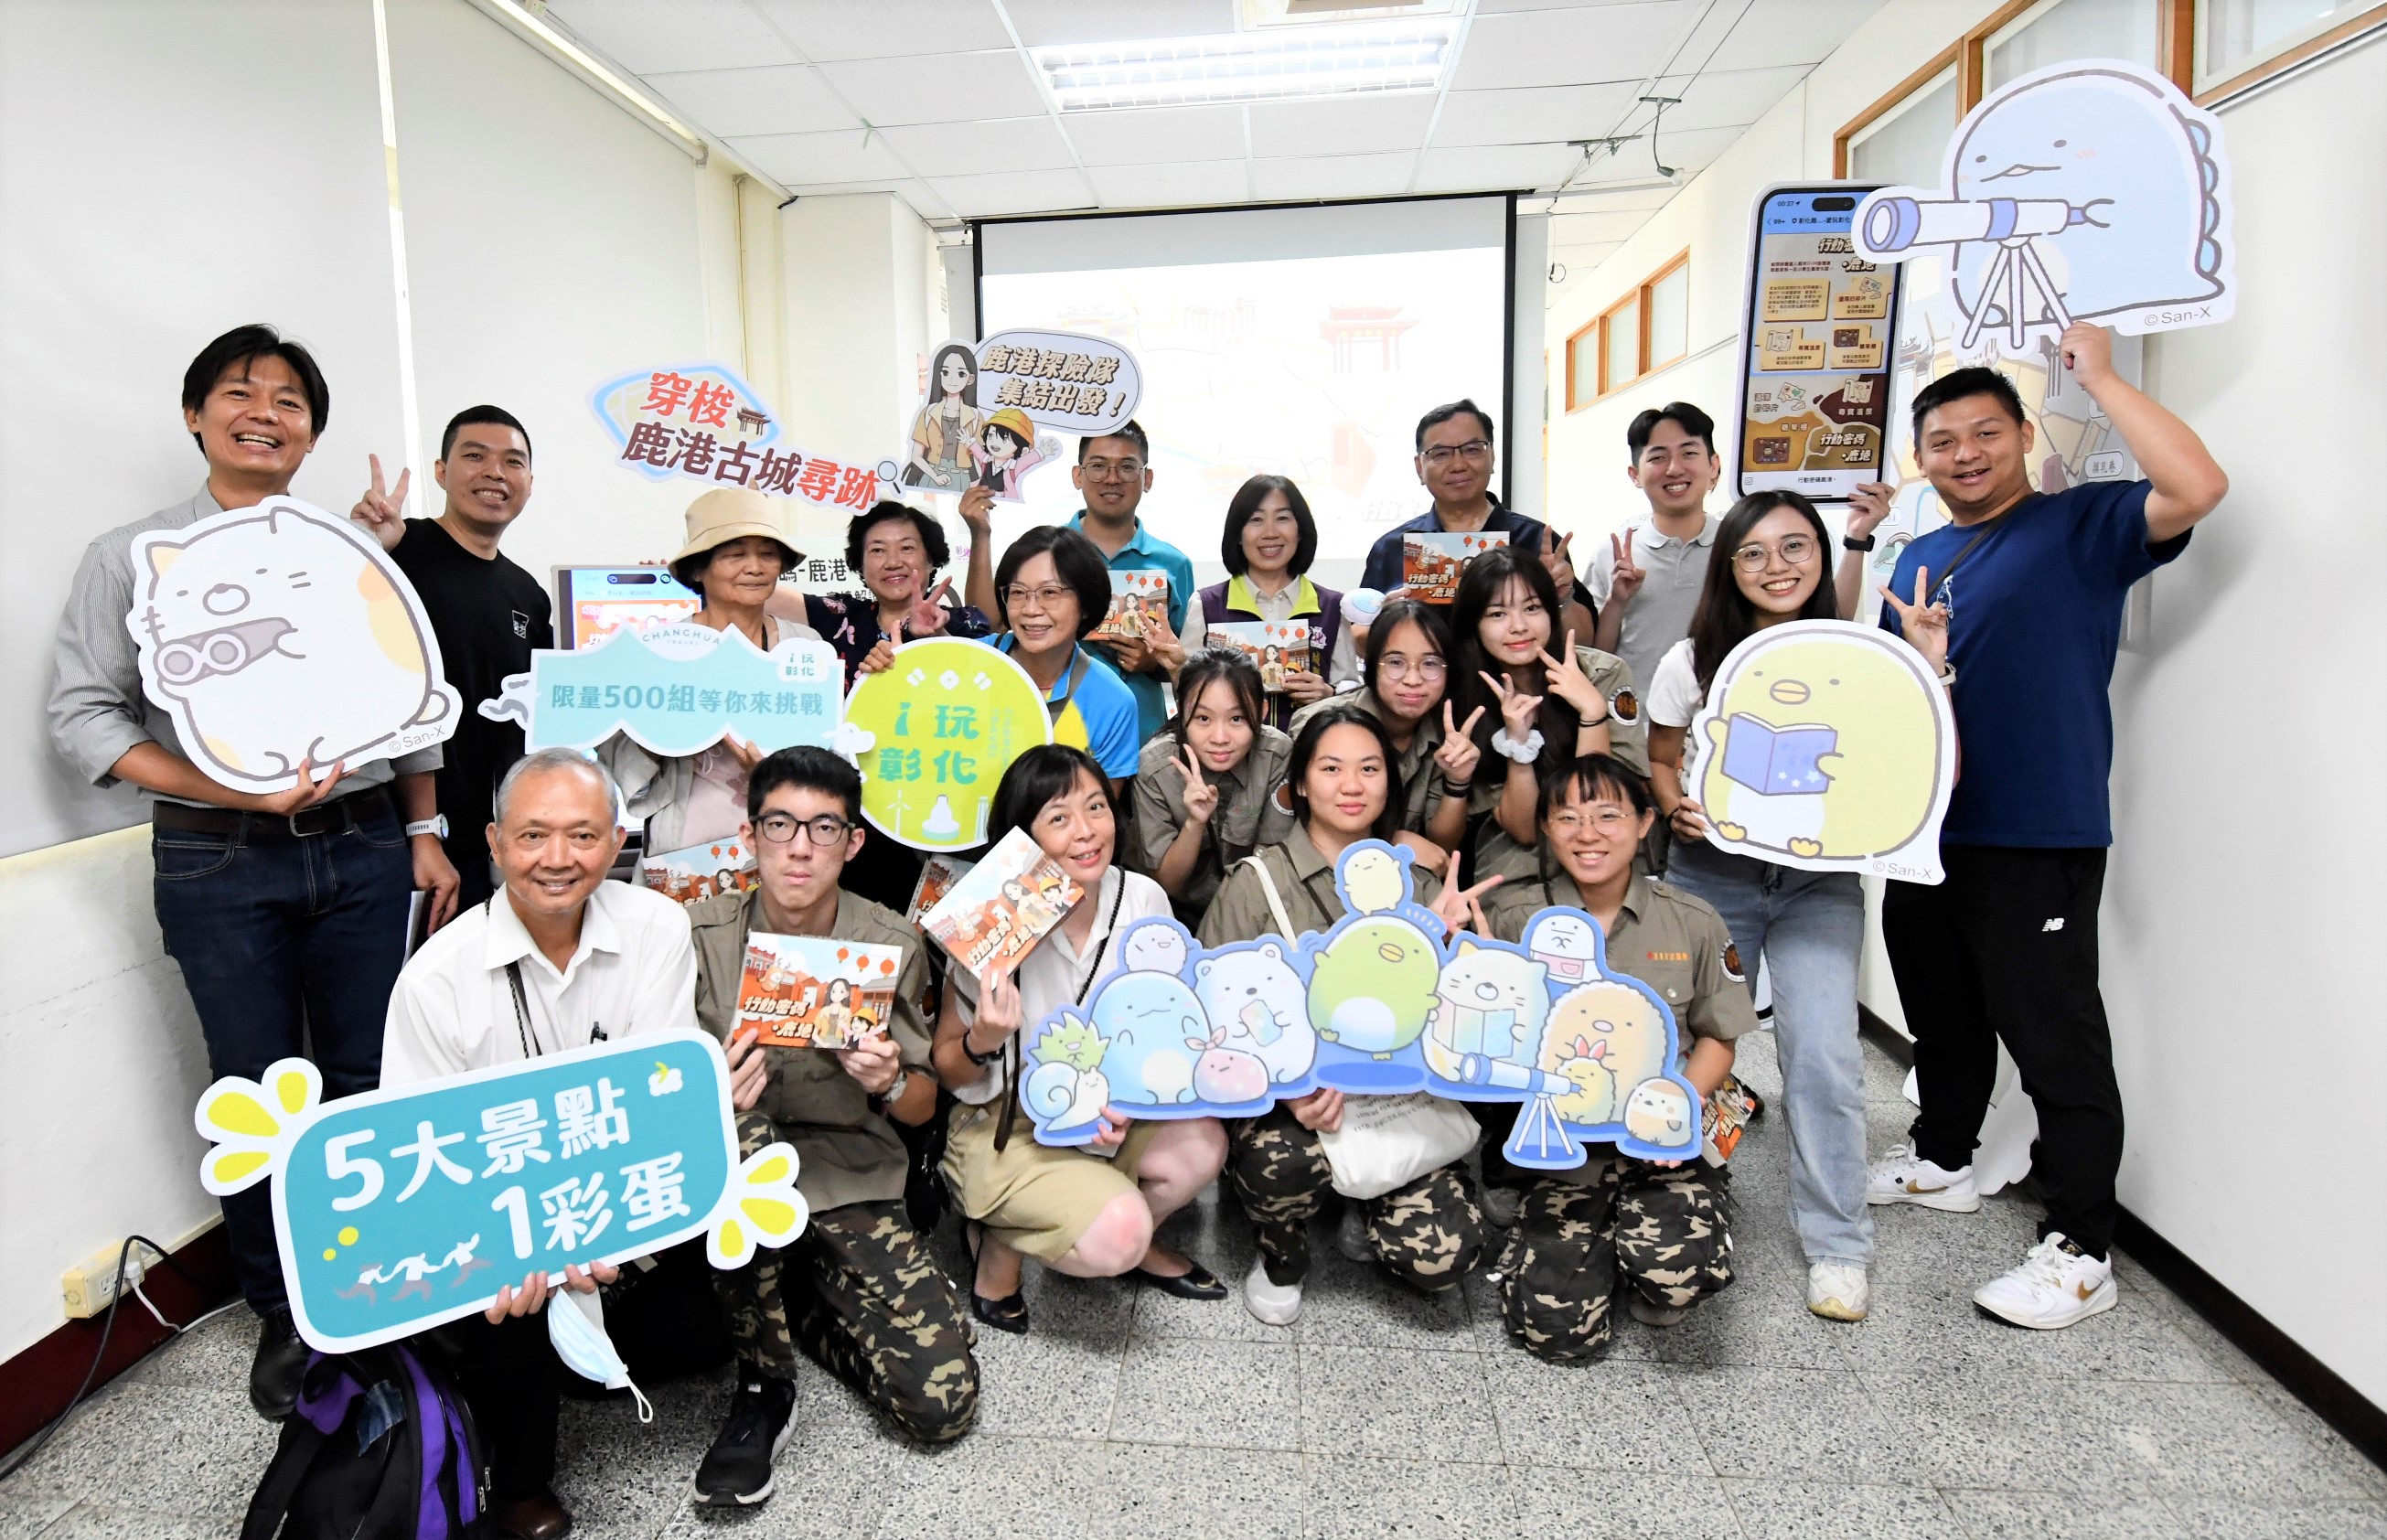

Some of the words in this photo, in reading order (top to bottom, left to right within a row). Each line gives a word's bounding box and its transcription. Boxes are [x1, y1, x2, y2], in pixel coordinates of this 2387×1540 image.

[979, 344, 1120, 386] 鹿港探險隊
[639, 371, 735, 429] 穿梭
[621, 421, 881, 510] 鹿港古城尋跡
[786, 666, 815, 676] 彰化
[551, 684, 823, 716] 限量500組等你來挑戰
[877, 746, 979, 786] 彰化
[744, 995, 811, 1018] 行動密碼
[324, 1076, 630, 1212] 5大景點
[491, 1151, 690, 1260] 1彩蛋
